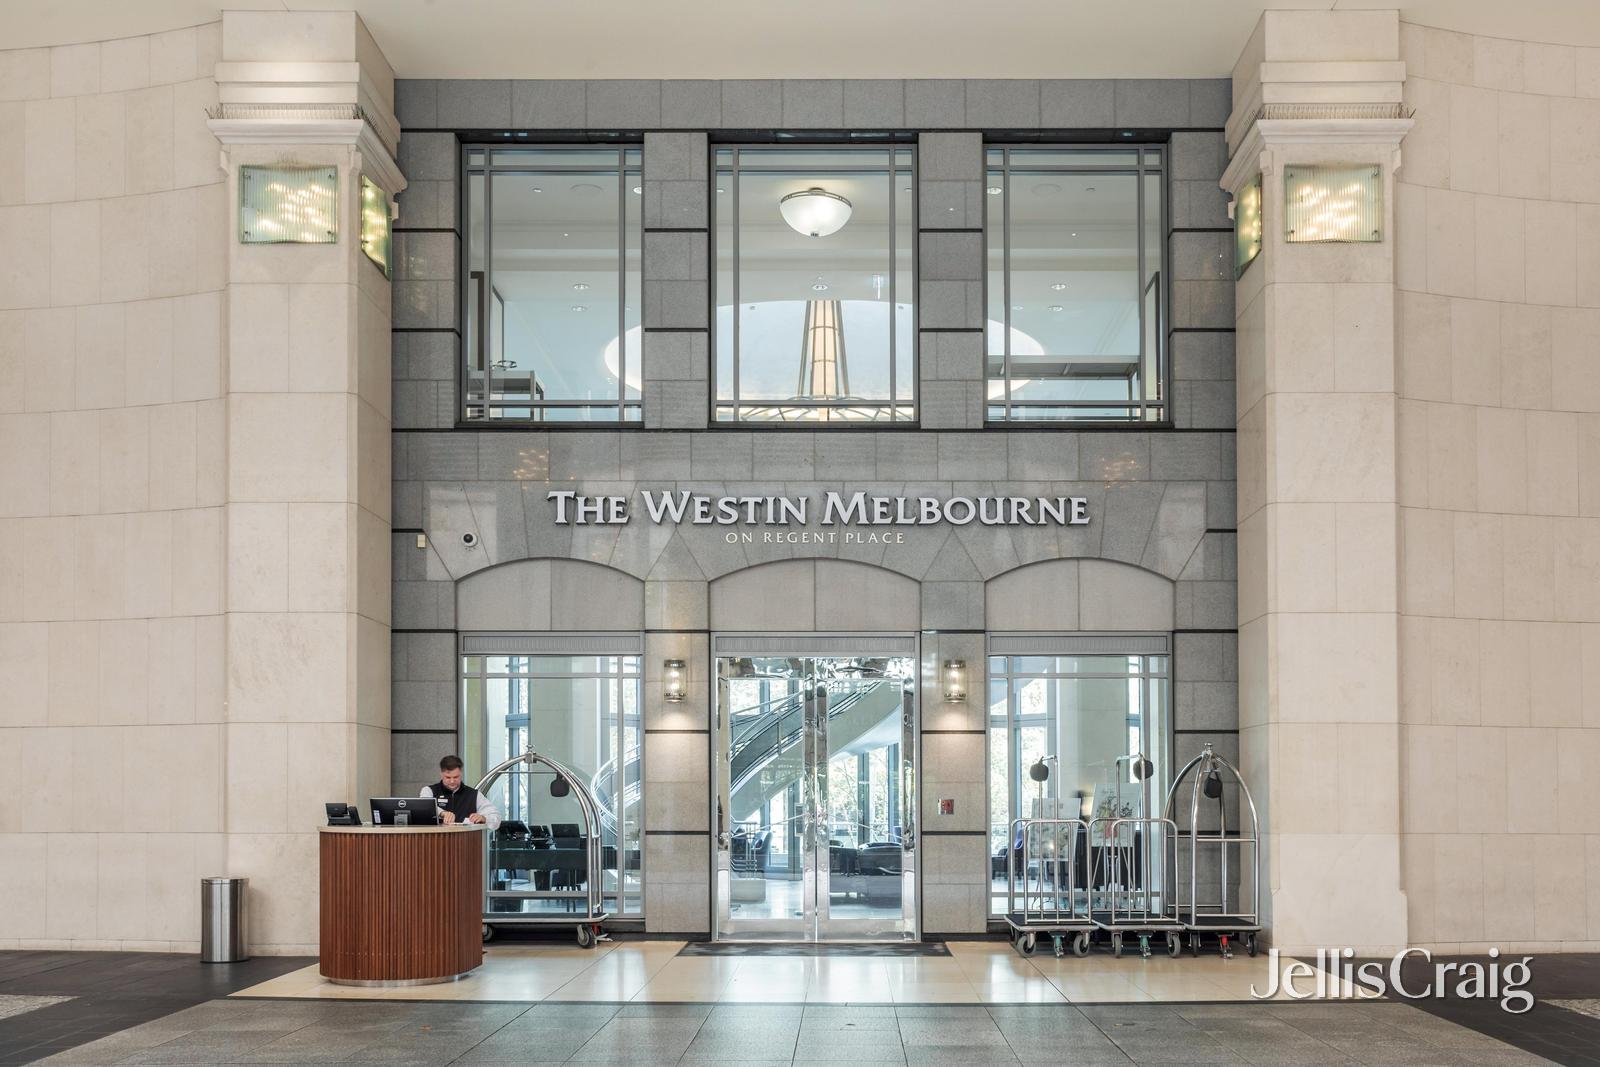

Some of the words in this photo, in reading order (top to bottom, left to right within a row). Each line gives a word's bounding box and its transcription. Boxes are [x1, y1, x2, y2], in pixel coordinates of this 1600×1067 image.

[547, 490, 630, 525] THE
[641, 490, 808, 525] WESTIN
[820, 491, 1091, 526] MELBOURNE
[725, 532, 753, 544] ON
[763, 532, 836, 544] REGENT
[845, 532, 904, 544] PLACE
